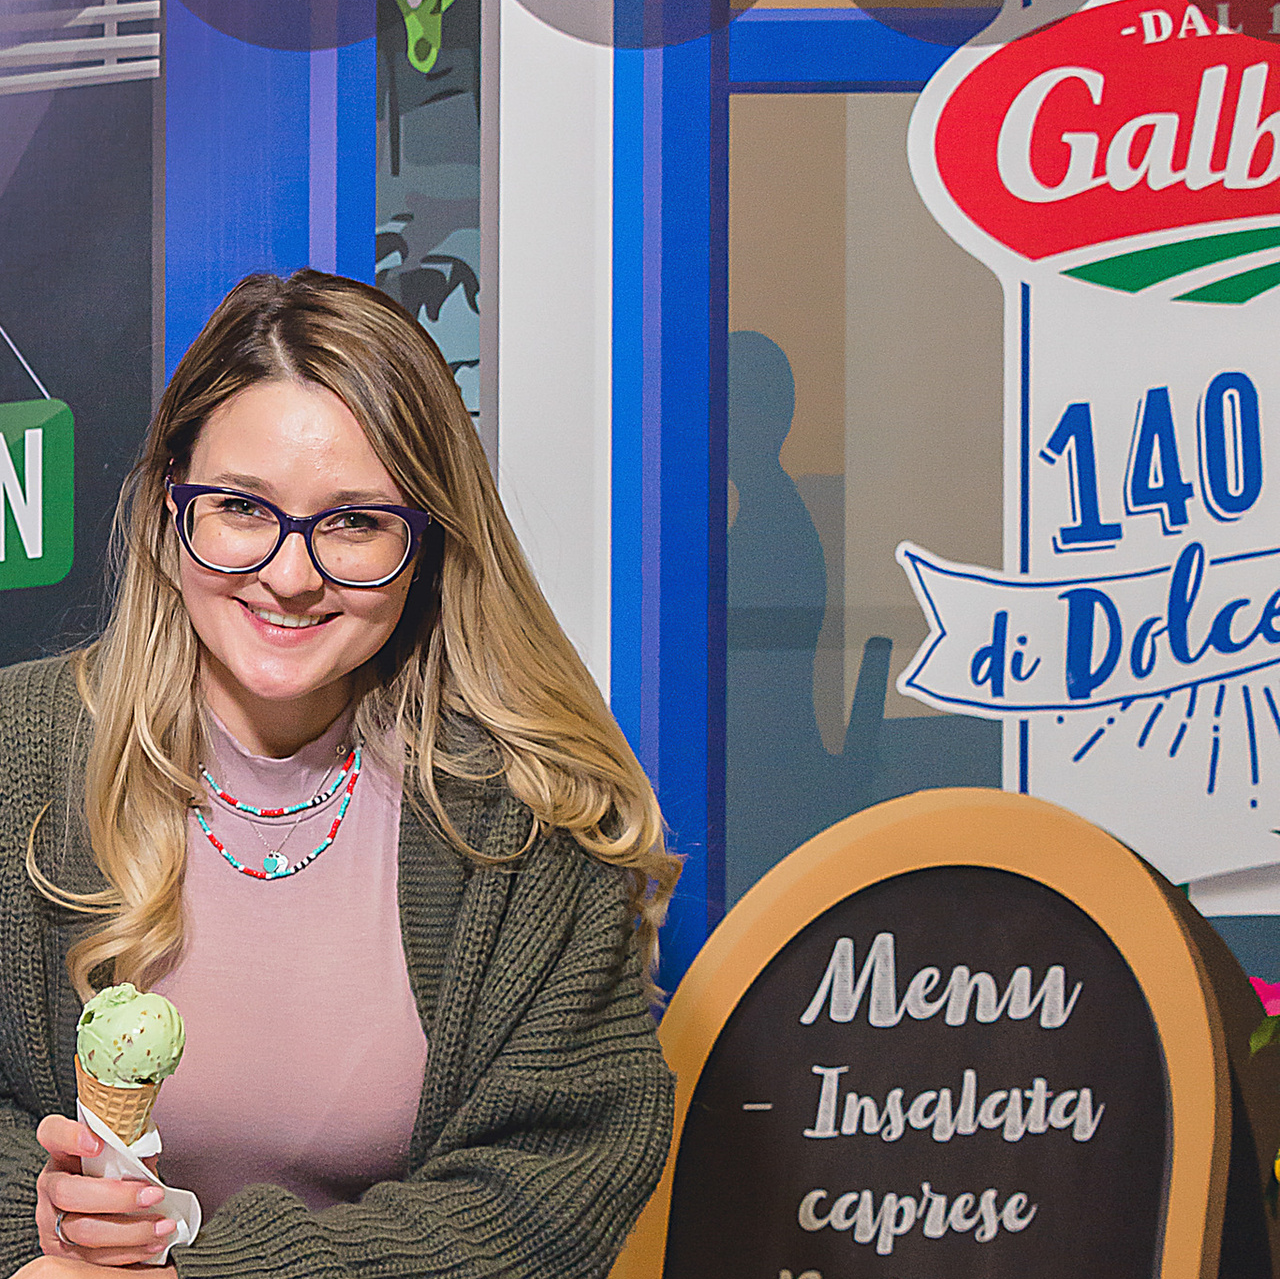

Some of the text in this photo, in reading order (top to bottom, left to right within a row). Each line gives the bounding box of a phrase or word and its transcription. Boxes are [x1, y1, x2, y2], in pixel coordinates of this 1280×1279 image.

[1038, 372, 1263, 554] 140
[970, 610, 1040, 698] di
[799, 932, 1083, 1028] Menu
[803, 1065, 1105, 1142] Insalata
[798, 1182, 1038, 1255] caprese
